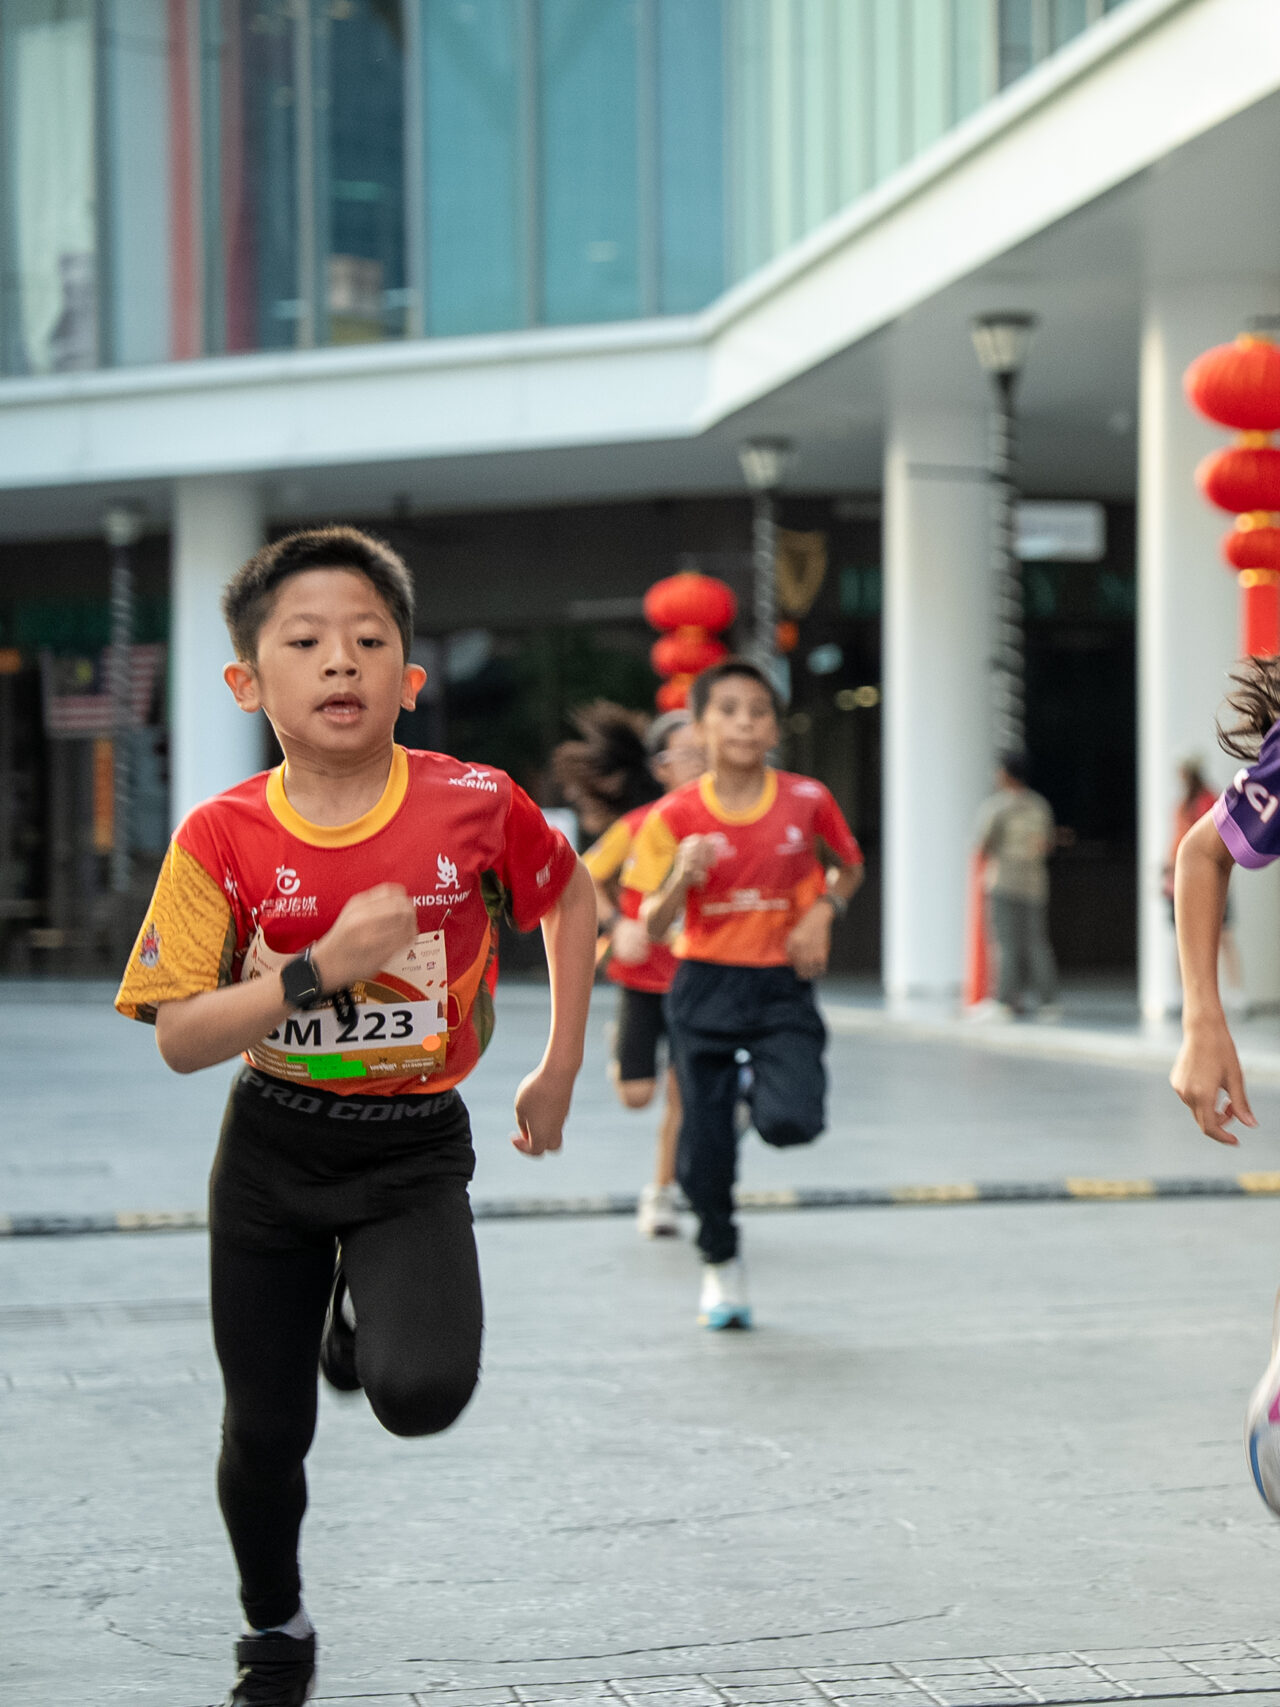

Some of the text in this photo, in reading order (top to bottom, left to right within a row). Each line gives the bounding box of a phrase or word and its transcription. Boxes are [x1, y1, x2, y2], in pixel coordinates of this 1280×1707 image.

[335, 1010, 414, 1044] 223
[241, 1072, 455, 1121] PRO COMB
